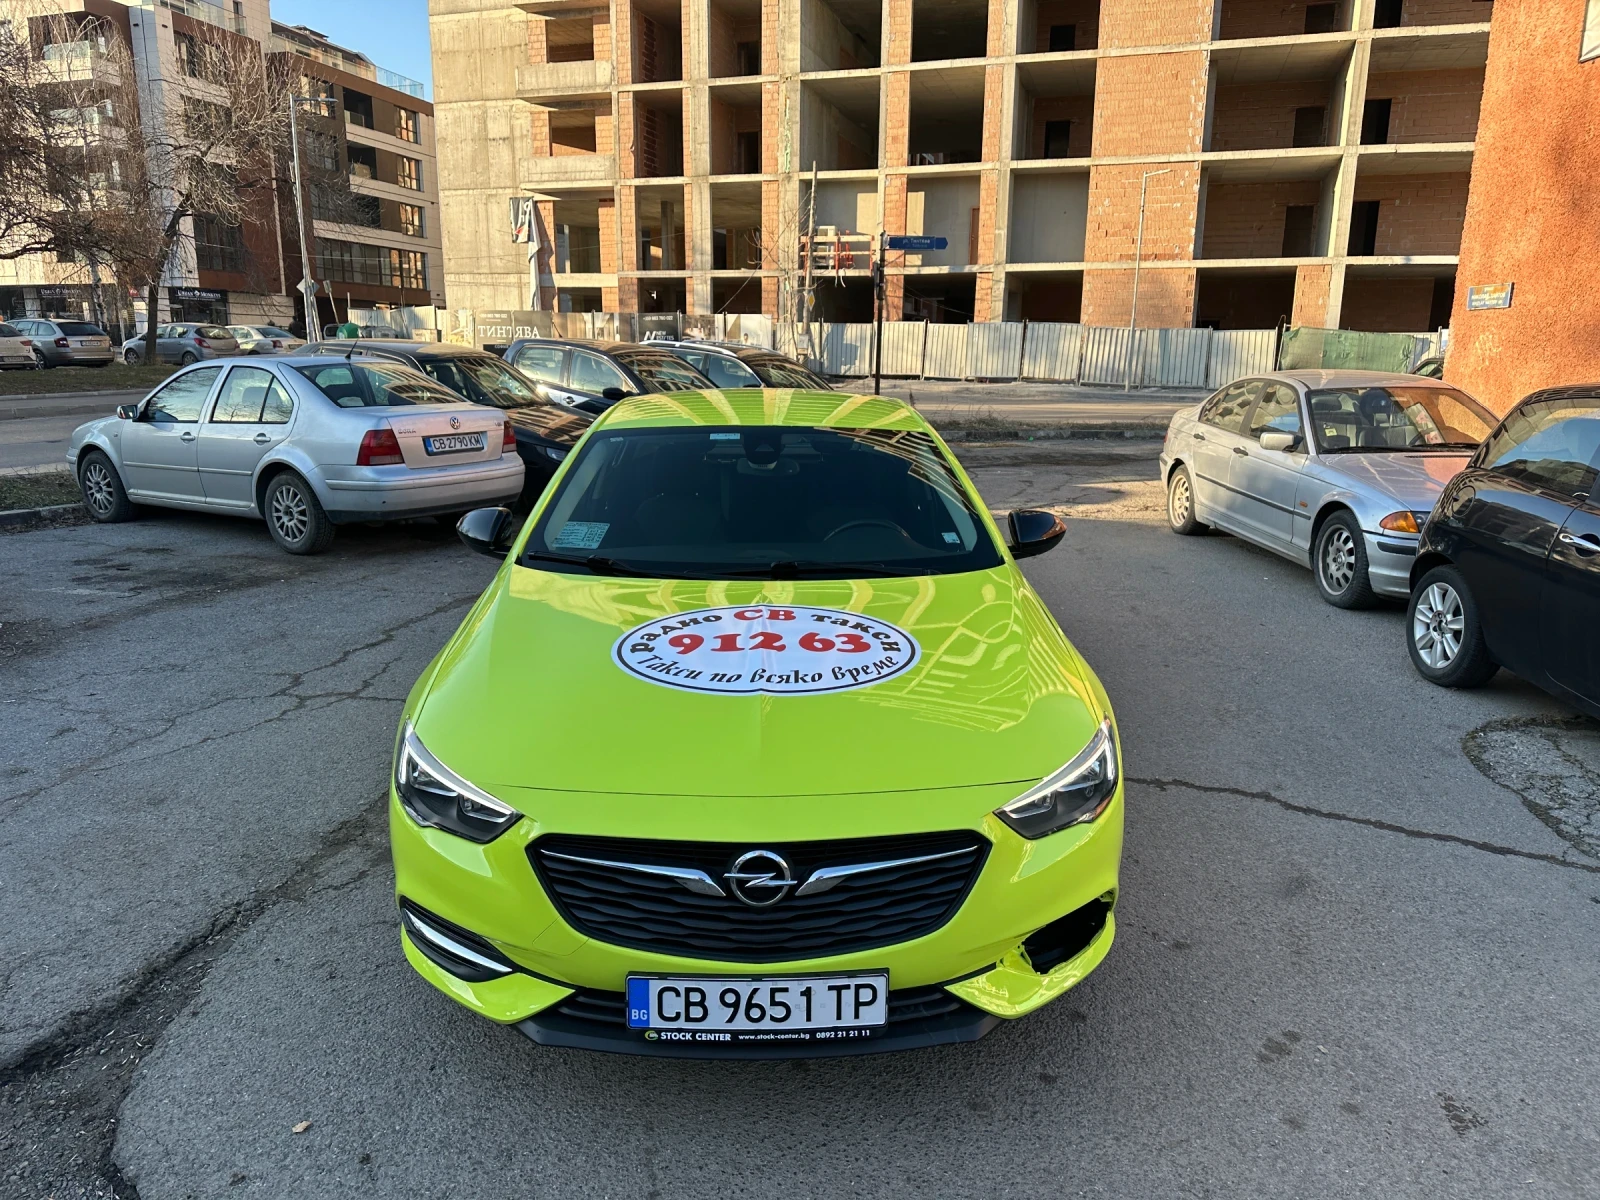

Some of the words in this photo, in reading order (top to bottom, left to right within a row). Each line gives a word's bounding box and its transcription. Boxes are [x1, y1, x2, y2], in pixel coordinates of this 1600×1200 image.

[478, 326, 540, 338] ТИНТЯВА
[433, 439, 446, 450] CB
[448, 436, 468, 448] 2790
[468, 436, 481, 446] KM
[734, 609, 796, 621] СВ
[811, 614, 902, 652] такси
[636, 654, 704, 680] Такси
[709, 672, 742, 683] по
[750, 668, 823, 684] всяко
[832, 656, 899, 682] време
[657, 986, 709, 1022] CB
[719, 986, 812, 1024] 9651
[828, 983, 878, 1020] TP
[631, 1009, 648, 1020] BG
[660, 1032, 692, 1040] STOCK
